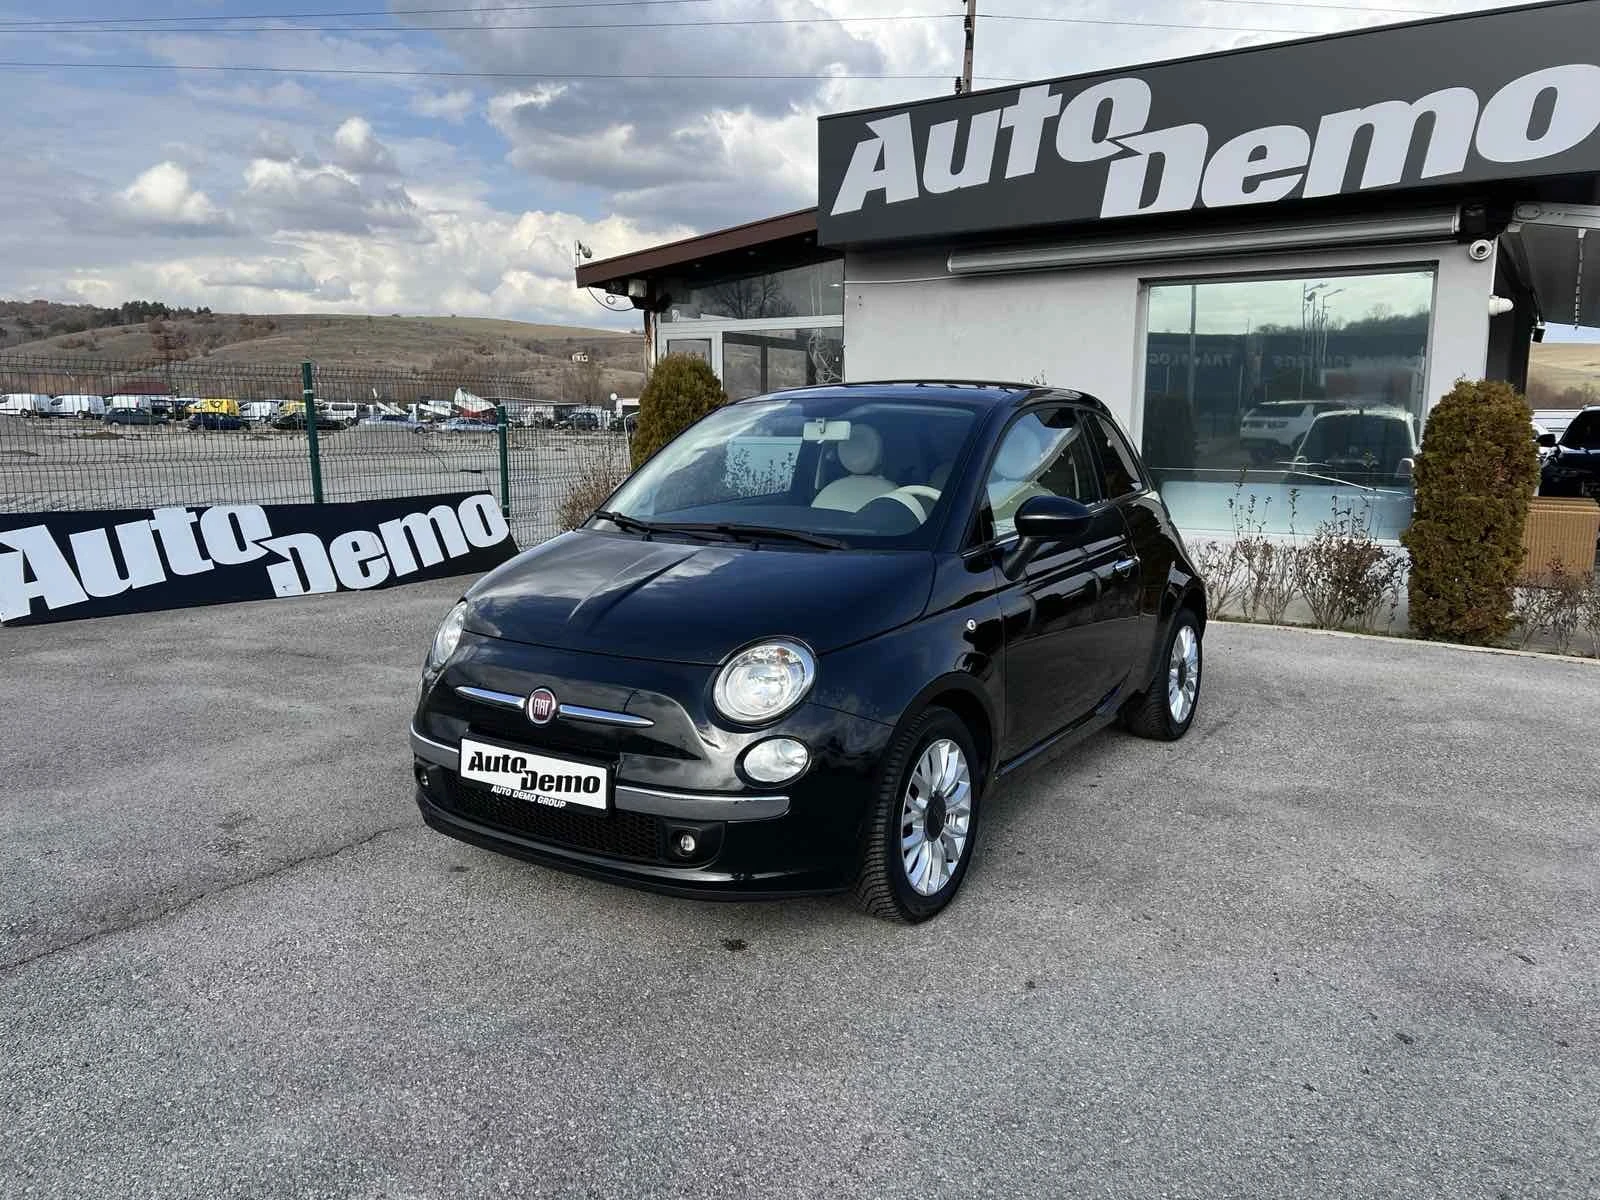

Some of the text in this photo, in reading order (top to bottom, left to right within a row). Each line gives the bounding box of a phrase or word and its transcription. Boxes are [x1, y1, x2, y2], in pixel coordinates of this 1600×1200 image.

[831, 63, 1600, 219] Auto Demo
[0, 493, 510, 623] Auto Demo
[533, 698, 551, 716] FIAT
[468, 751, 601, 794] Auto Demo
[491, 785, 566, 808] AUTO DEMO GROUP
